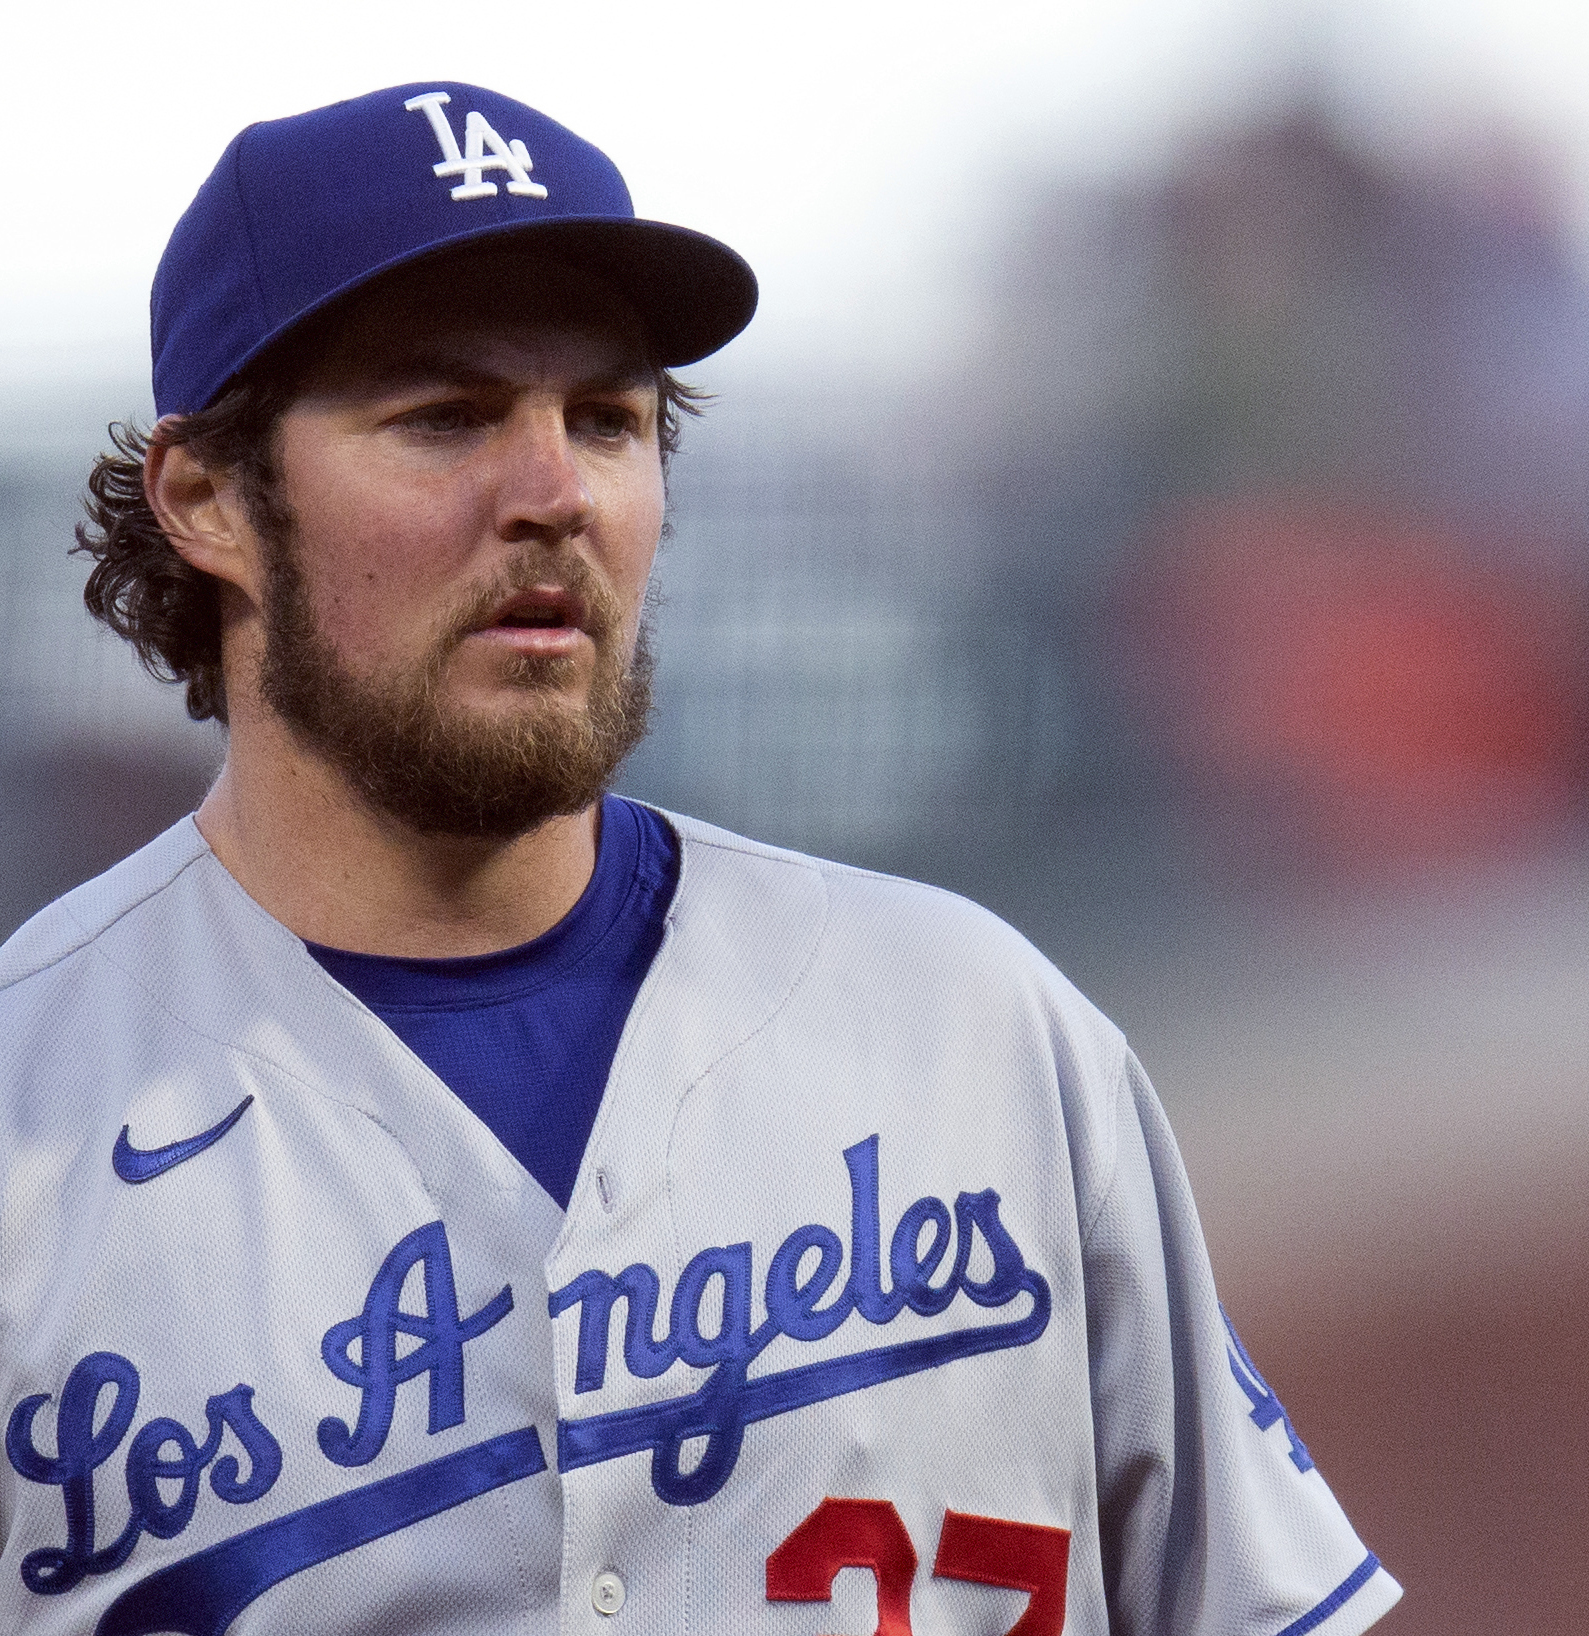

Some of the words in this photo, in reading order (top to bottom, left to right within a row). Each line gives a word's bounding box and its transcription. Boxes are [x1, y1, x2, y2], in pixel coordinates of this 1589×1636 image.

[404, 91, 548, 201] LA
[6, 1351, 283, 1596] Los
[318, 1133, 1051, 1505] Angeles
